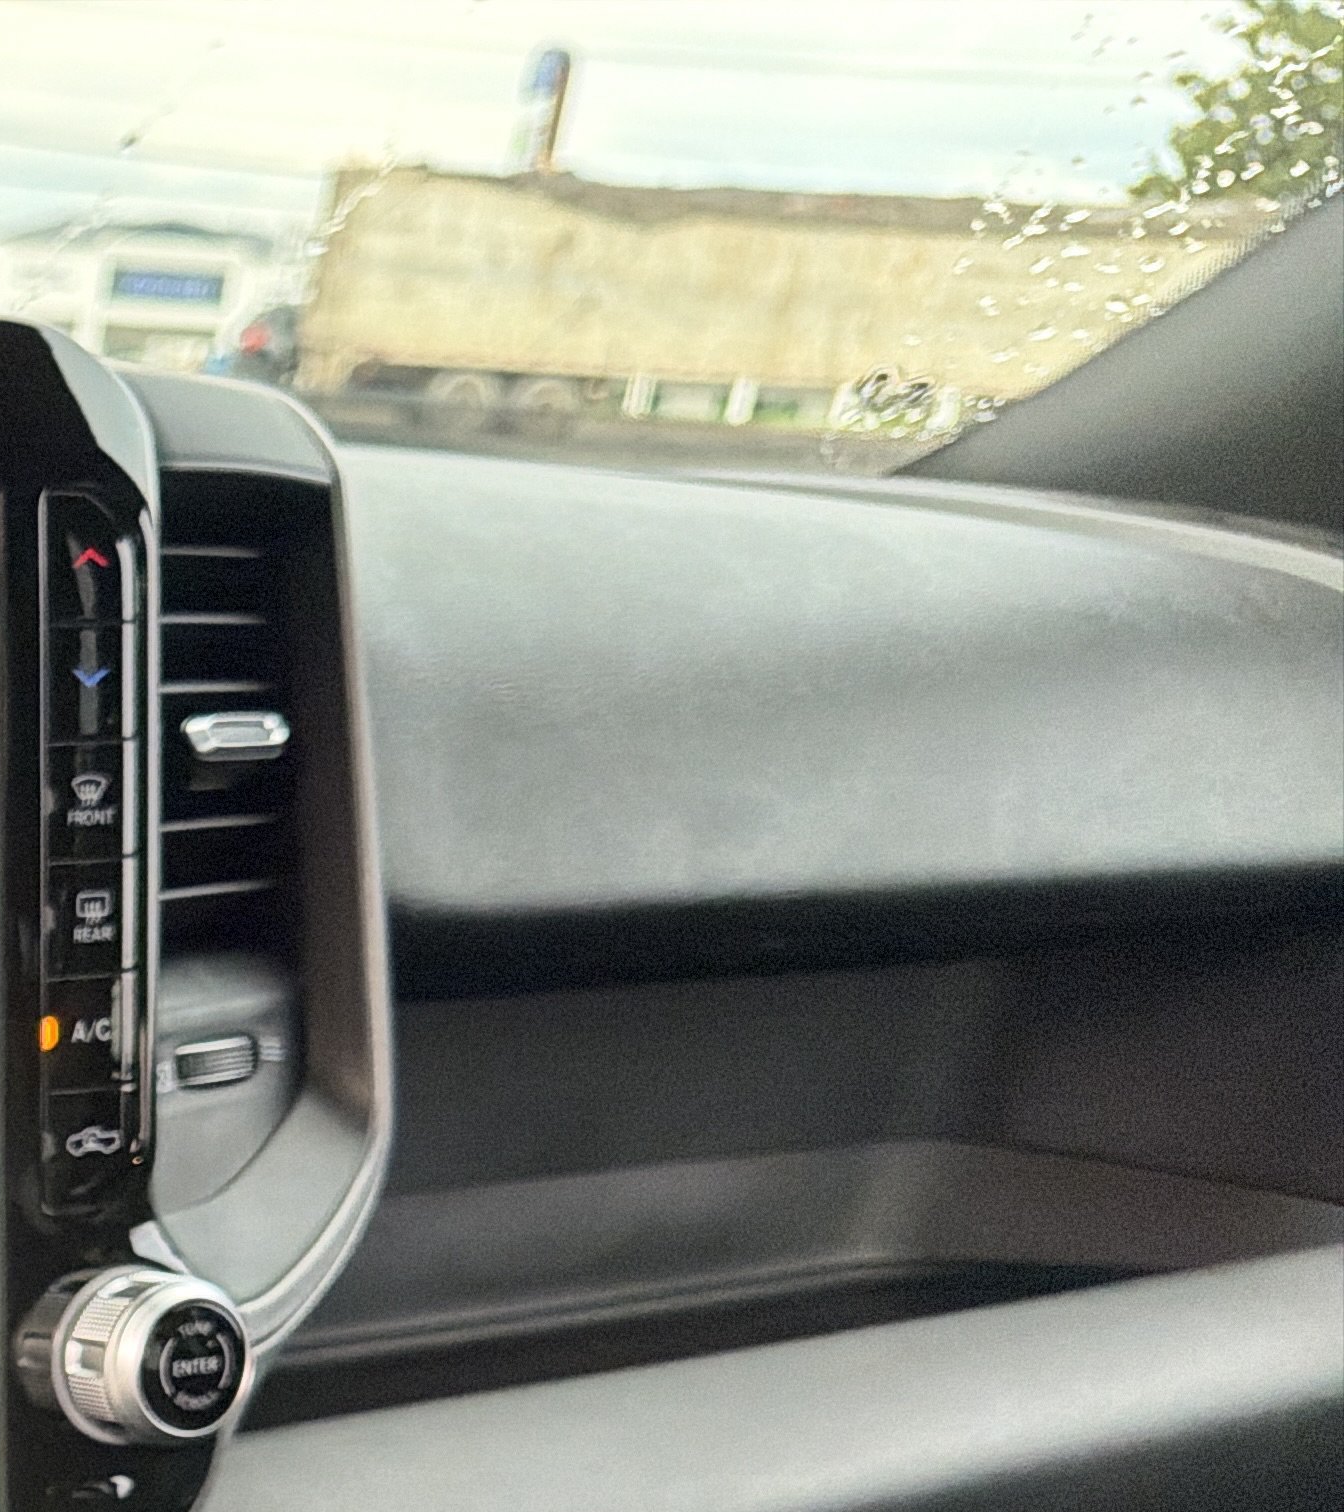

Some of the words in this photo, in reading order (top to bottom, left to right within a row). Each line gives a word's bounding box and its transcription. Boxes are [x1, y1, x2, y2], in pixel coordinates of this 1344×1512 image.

[66, 808, 115, 827] FRONT
[73, 924, 115, 944] REAR
[71, 1017, 112, 1044] A/C
[172, 1355, 219, 1378] ENTER
